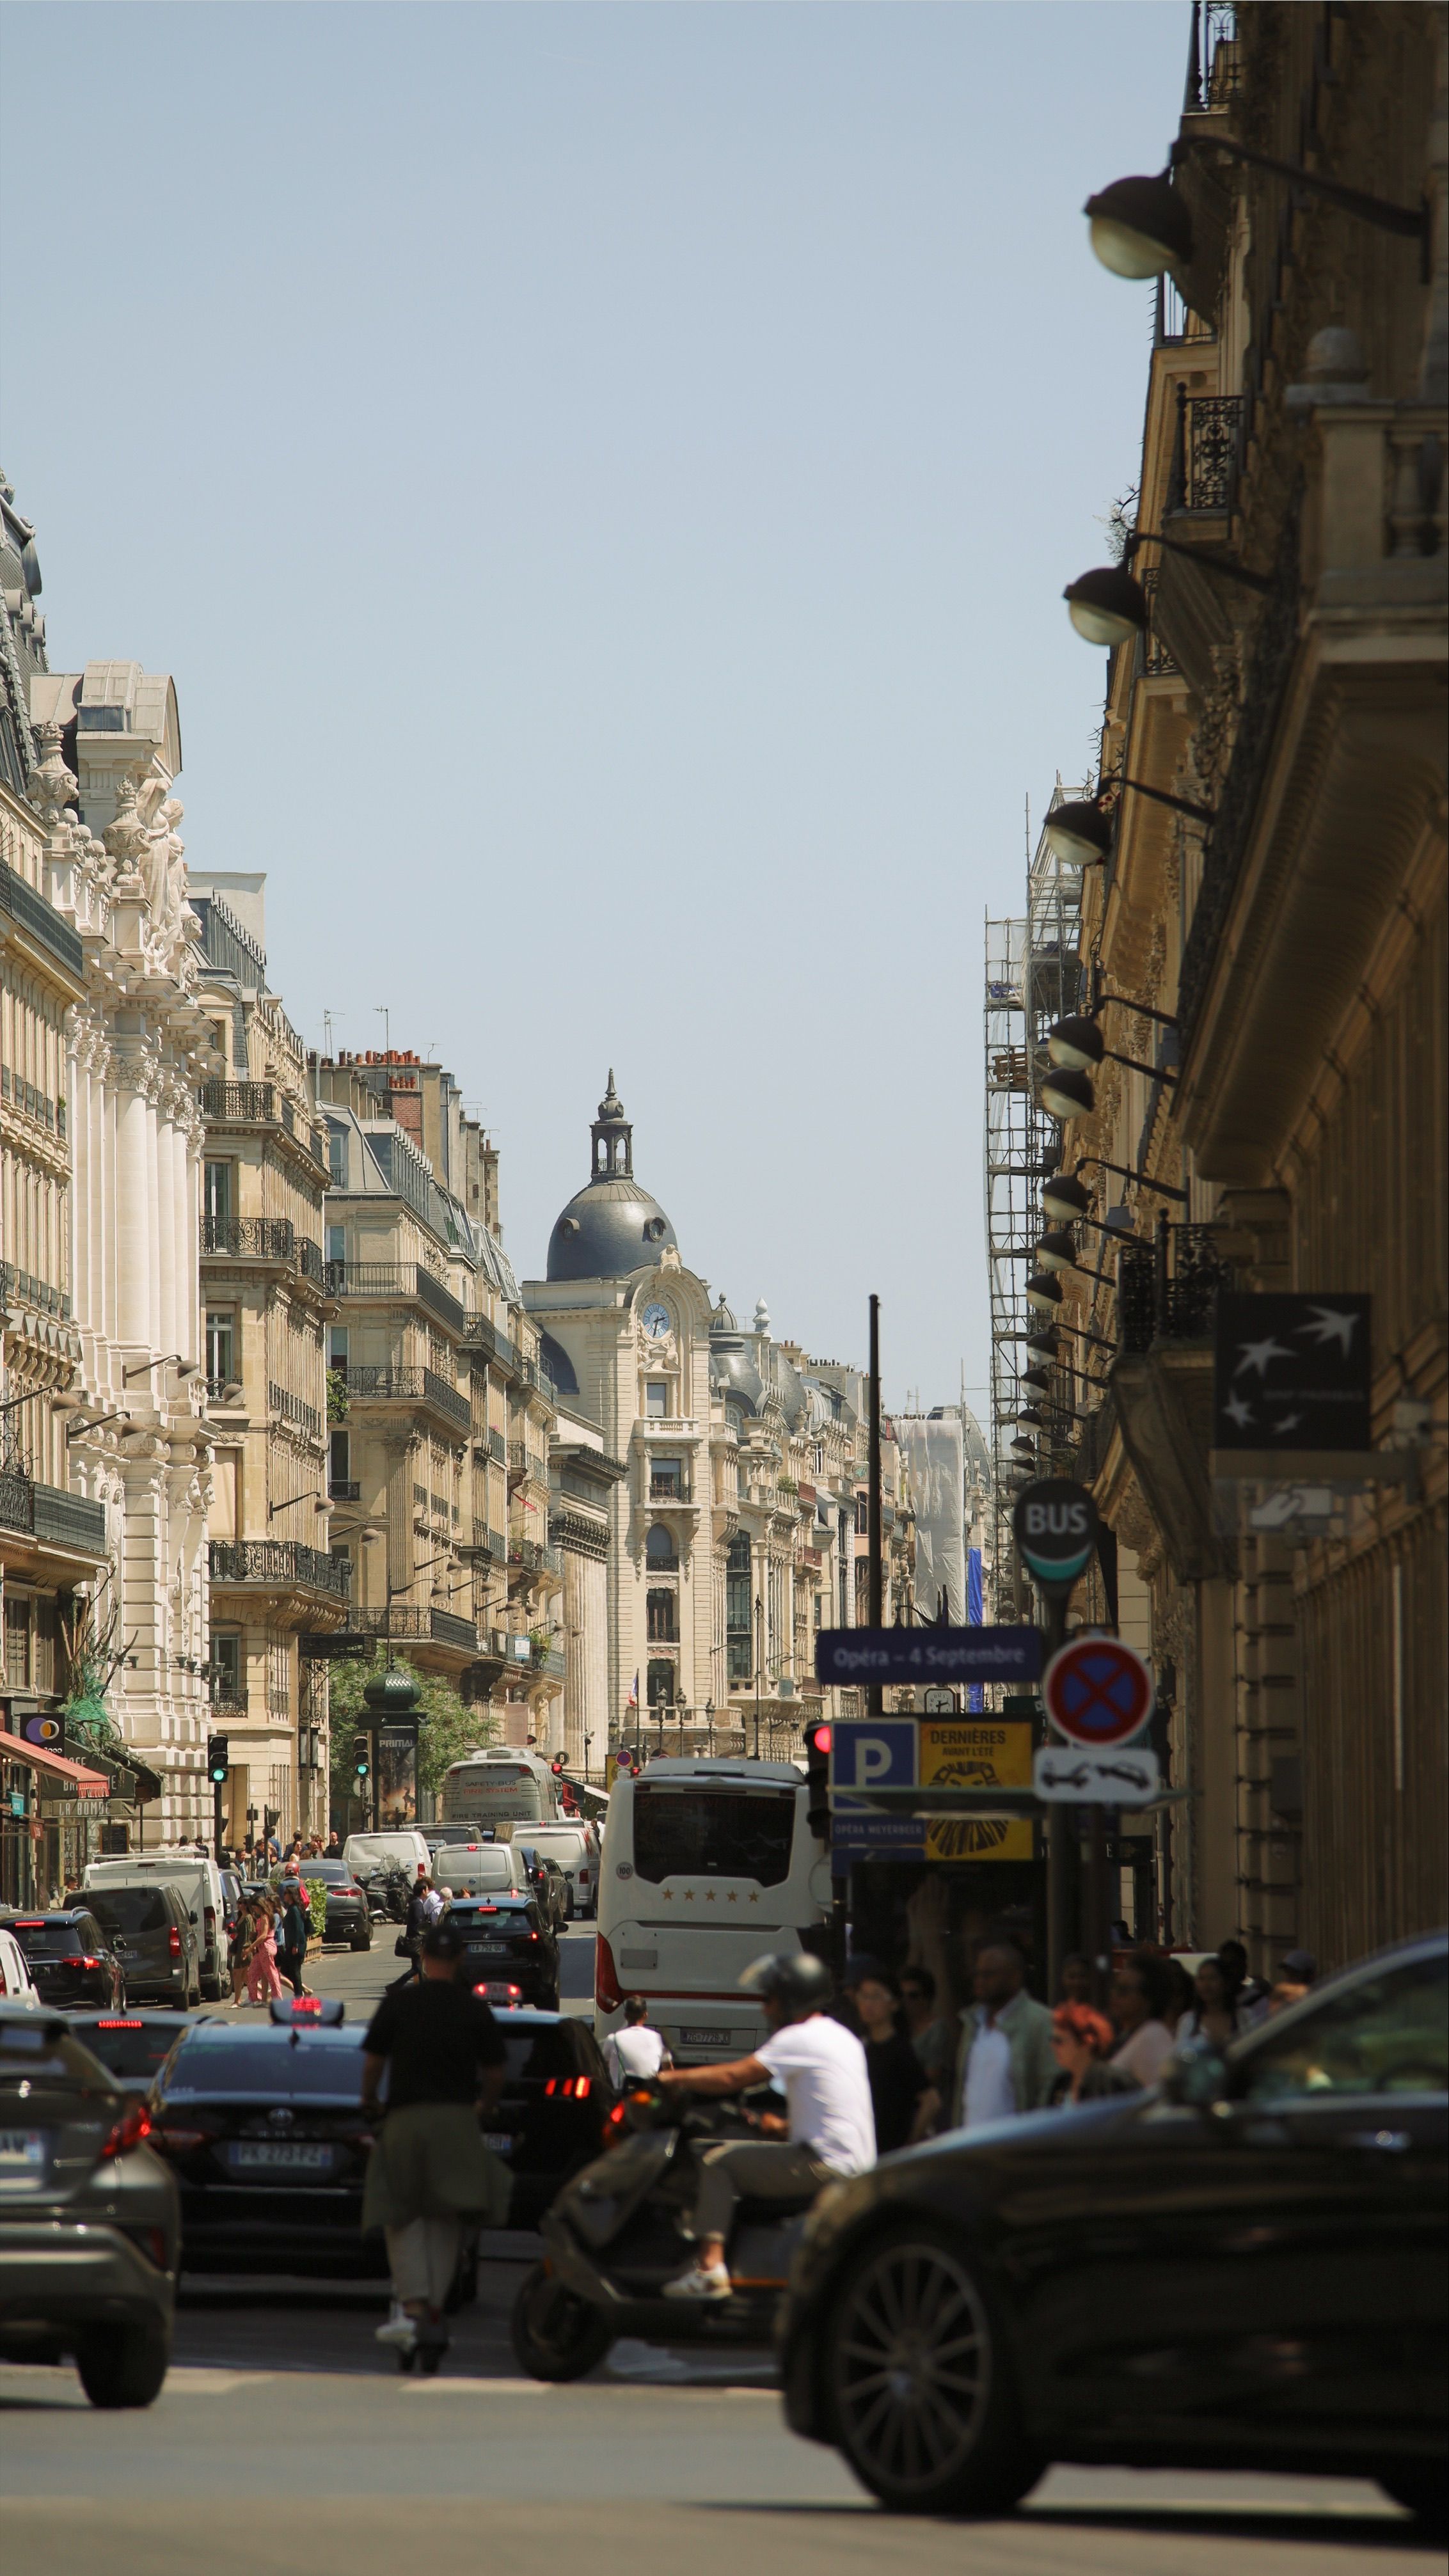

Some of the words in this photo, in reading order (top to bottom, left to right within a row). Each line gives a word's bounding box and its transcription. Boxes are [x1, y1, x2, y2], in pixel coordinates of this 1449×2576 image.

[1026, 1503, 1088, 1534] BUS
[833, 1646, 890, 1670] Opéra
[909, 1646, 922, 1664] 4
[925, 1644, 1025, 1668] Septembre
[930, 1728, 1006, 1744] DERNIÈRES
[379, 1739, 414, 1748] PRIMAL
[942, 1747, 970, 1757] AVANT
[854, 1738, 893, 1787] P
[59, 1802, 71, 1815] LA
[619, 1867, 630, 1875] 100
